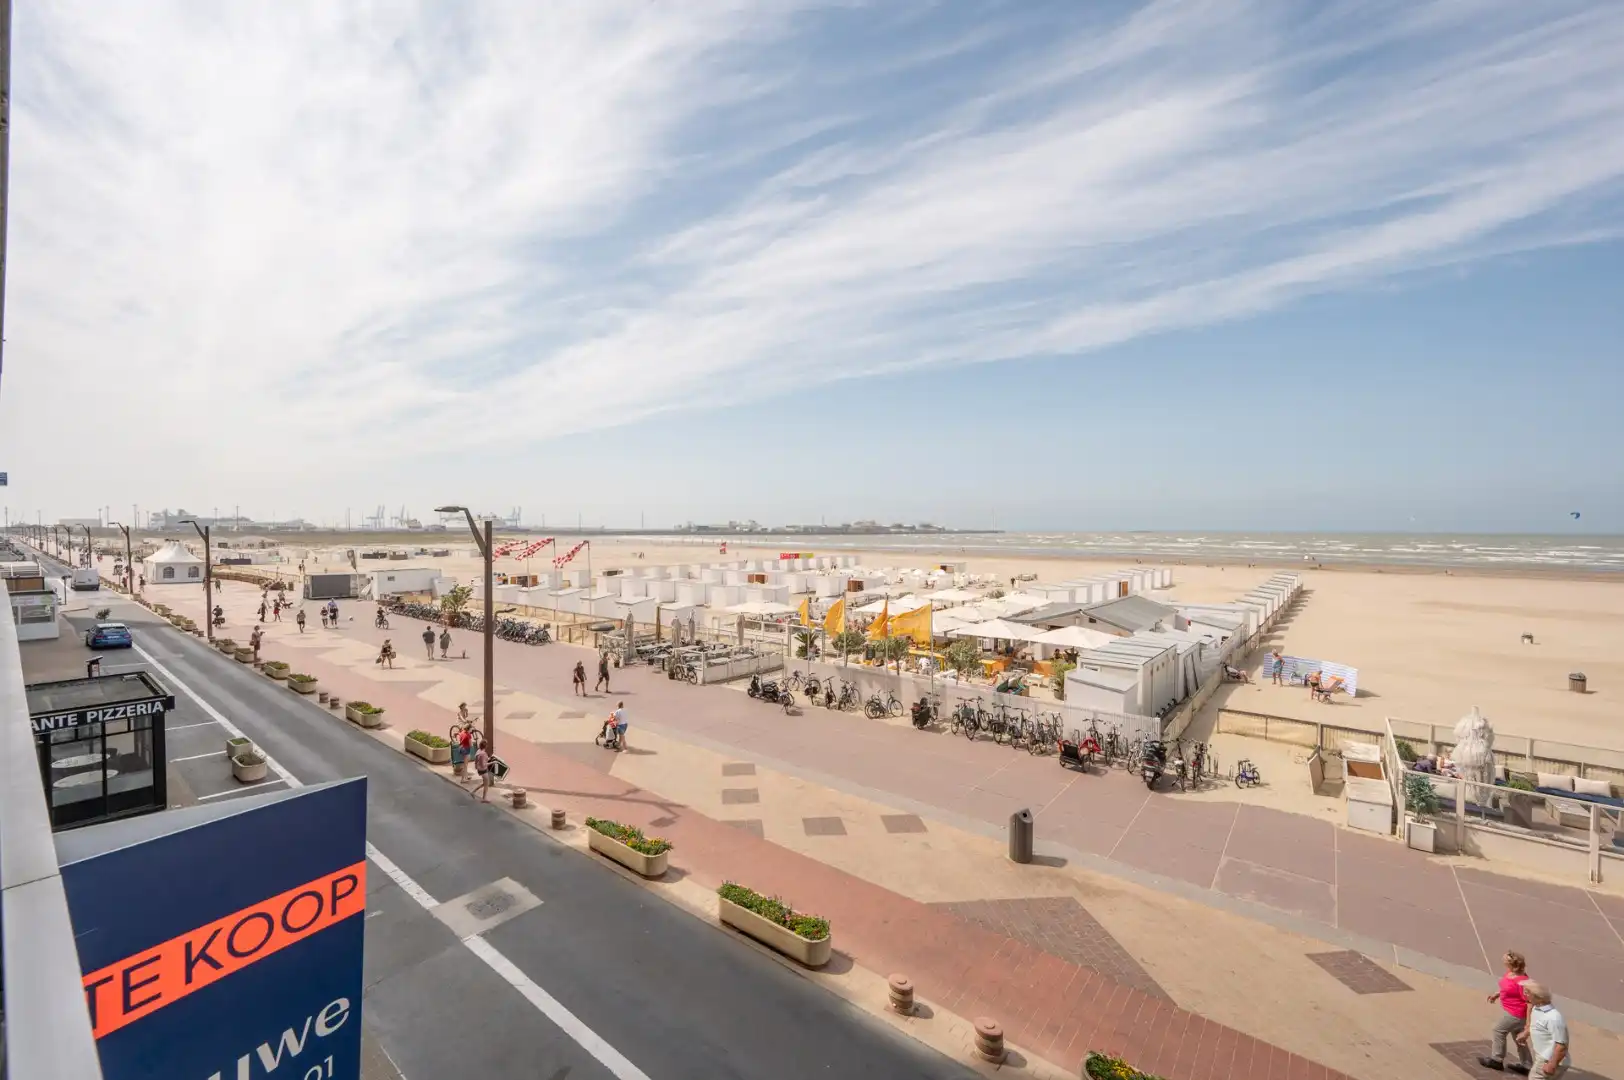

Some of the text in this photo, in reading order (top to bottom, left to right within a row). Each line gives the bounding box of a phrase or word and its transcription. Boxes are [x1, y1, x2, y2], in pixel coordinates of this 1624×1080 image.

[86, 701, 164, 723] PIZZERIA
[84, 874, 358, 1030] TE KOOP
